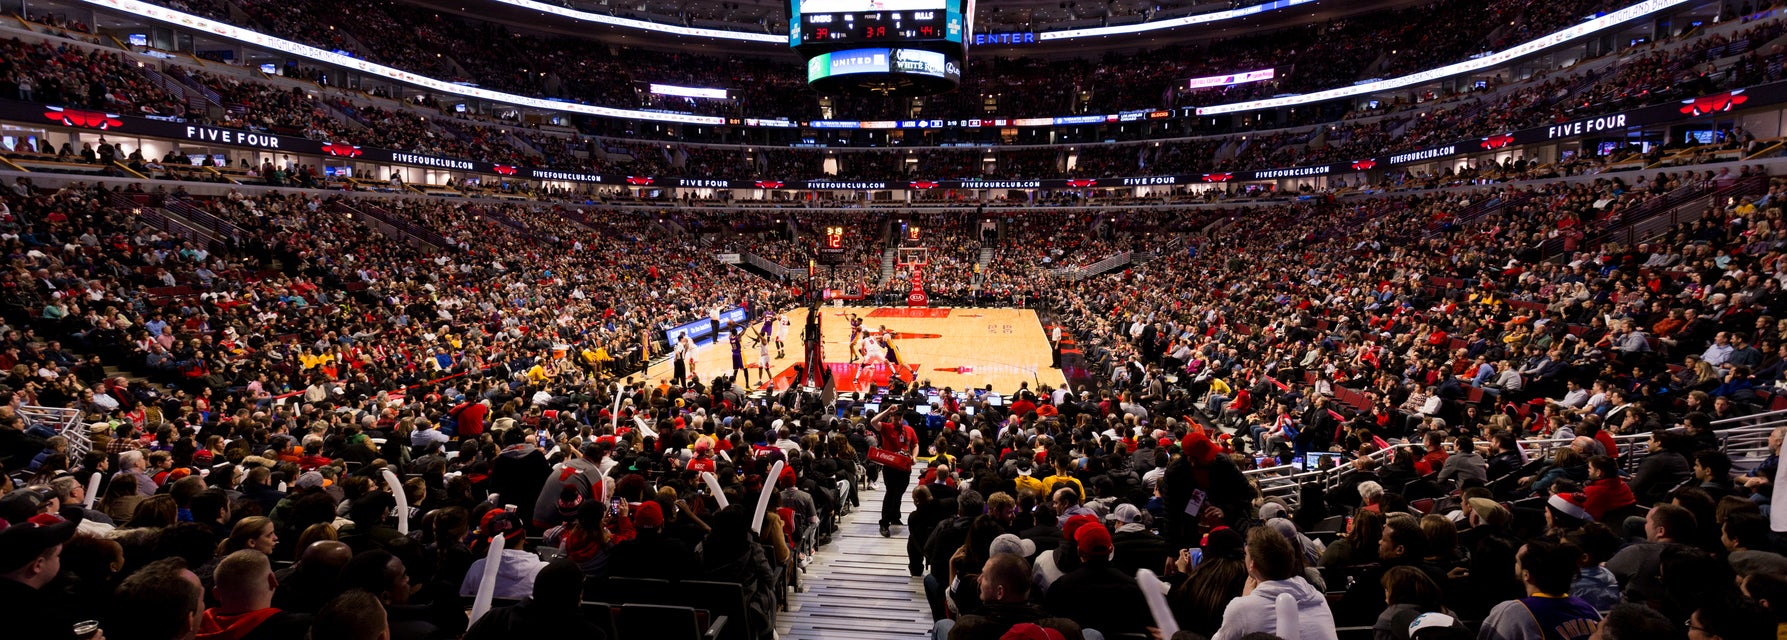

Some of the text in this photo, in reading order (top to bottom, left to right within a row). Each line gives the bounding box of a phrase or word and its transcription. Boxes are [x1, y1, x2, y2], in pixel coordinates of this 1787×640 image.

[810, 15, 833, 24] LAKERS
[914, 12, 934, 20] BULLS
[816, 28, 829, 39] 39
[920, 26, 933, 36] 44
[976, 33, 1034, 44] ENTER
[268, 37, 308, 55] HIGHLAND
[308, 47, 336, 62] BAKING
[832, 56, 872, 67] UNITED
[897, 61, 924, 70] WHITE
[1548, 114, 1626, 139] FIVE FOUR
[187, 126, 279, 148] FIVE FOUR
[1390, 146, 1455, 164] FIVEFOURCLUB.COM
[392, 152, 473, 170] FIVEFOURCLUB.COM
[532, 170, 601, 182] FIVEFOURCLUB.COM
[1255, 165, 1330, 179] FIVEFOURCLUB.COM
[680, 179, 728, 188] FIVE FOUR
[961, 181, 1040, 189] FIVEFOURCLUB.COM
[1123, 176, 1175, 186] FIVE FOUR
[826, 227, 843, 235] 3:19
[829, 235, 840, 247] 12
